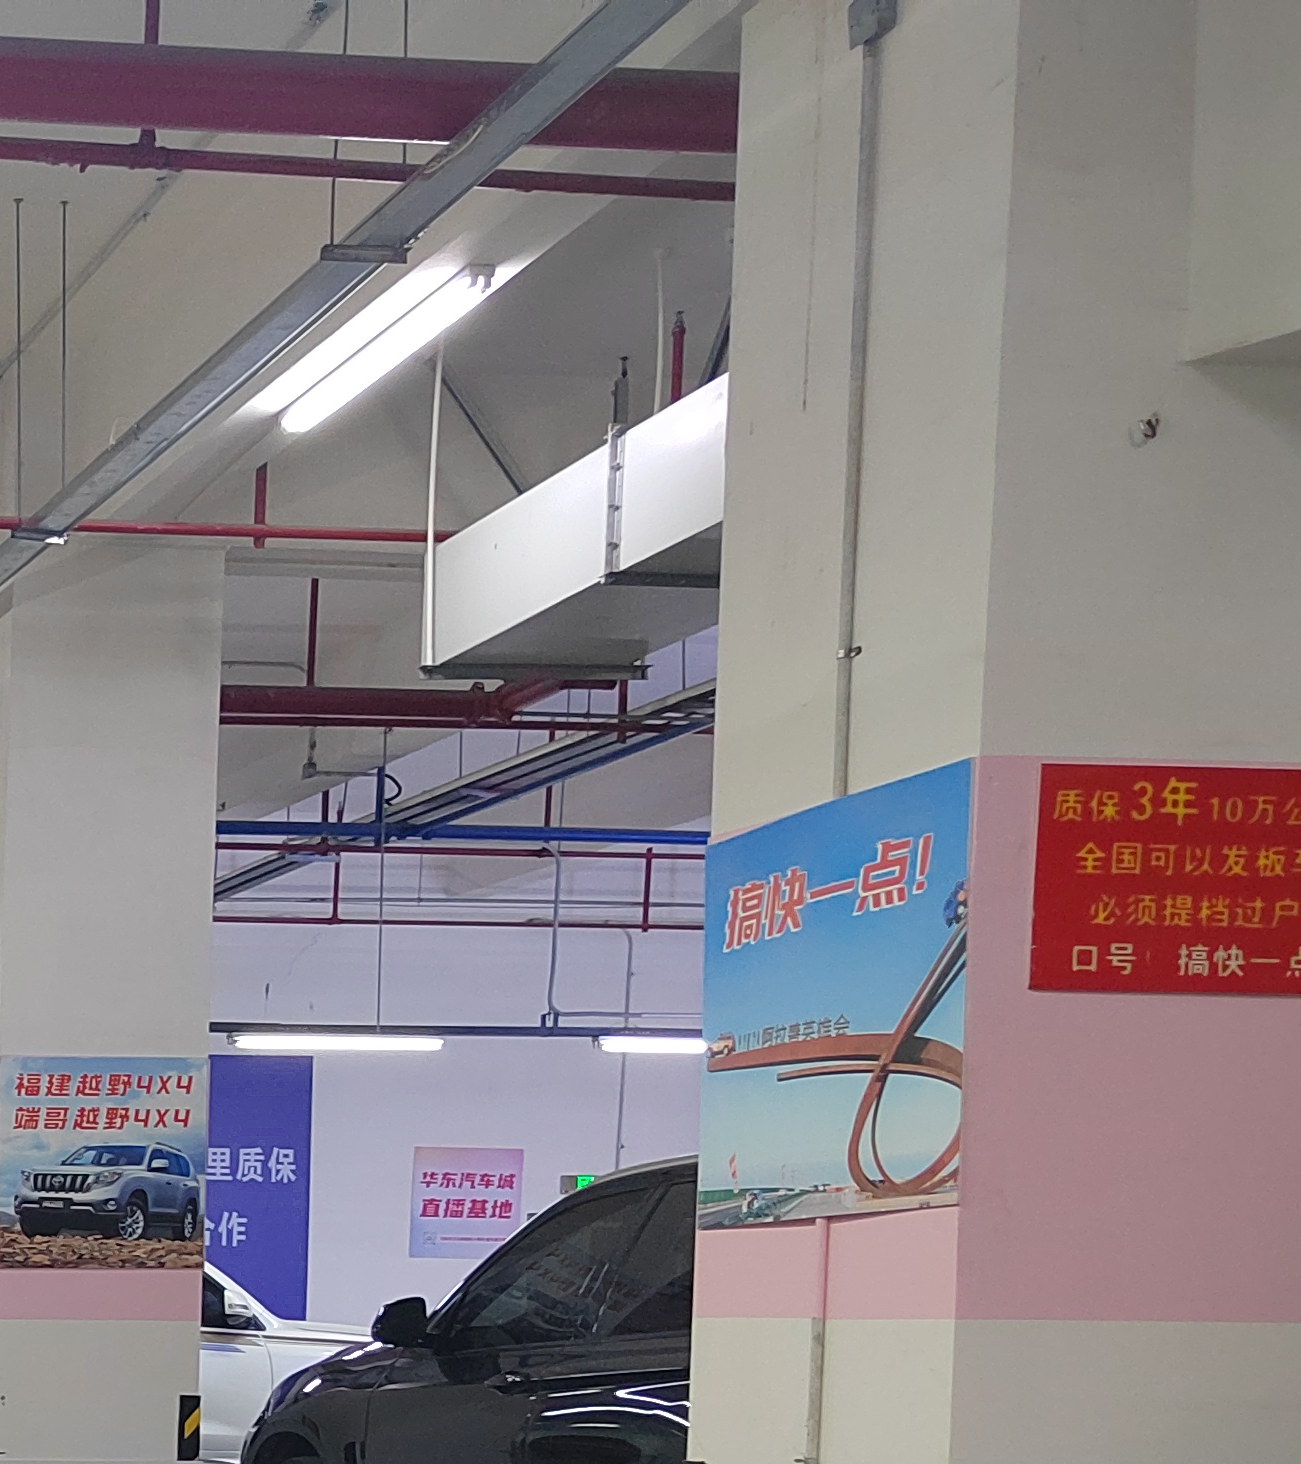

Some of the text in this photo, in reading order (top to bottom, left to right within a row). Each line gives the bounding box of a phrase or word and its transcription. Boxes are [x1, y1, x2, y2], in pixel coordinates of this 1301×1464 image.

[1089, 894, 1300, 928] 必须提档过户
[1072, 943, 1136, 975] 口号
[14, 1073, 194, 1097] 福建越野4X4
[13, 1106, 191, 1130] 端哥越野4X4
[205, 1146, 297, 1183] 里质保
[419, 1171, 517, 1190] 华东汽车城
[419, 1198, 513, 1219] 直播基地
